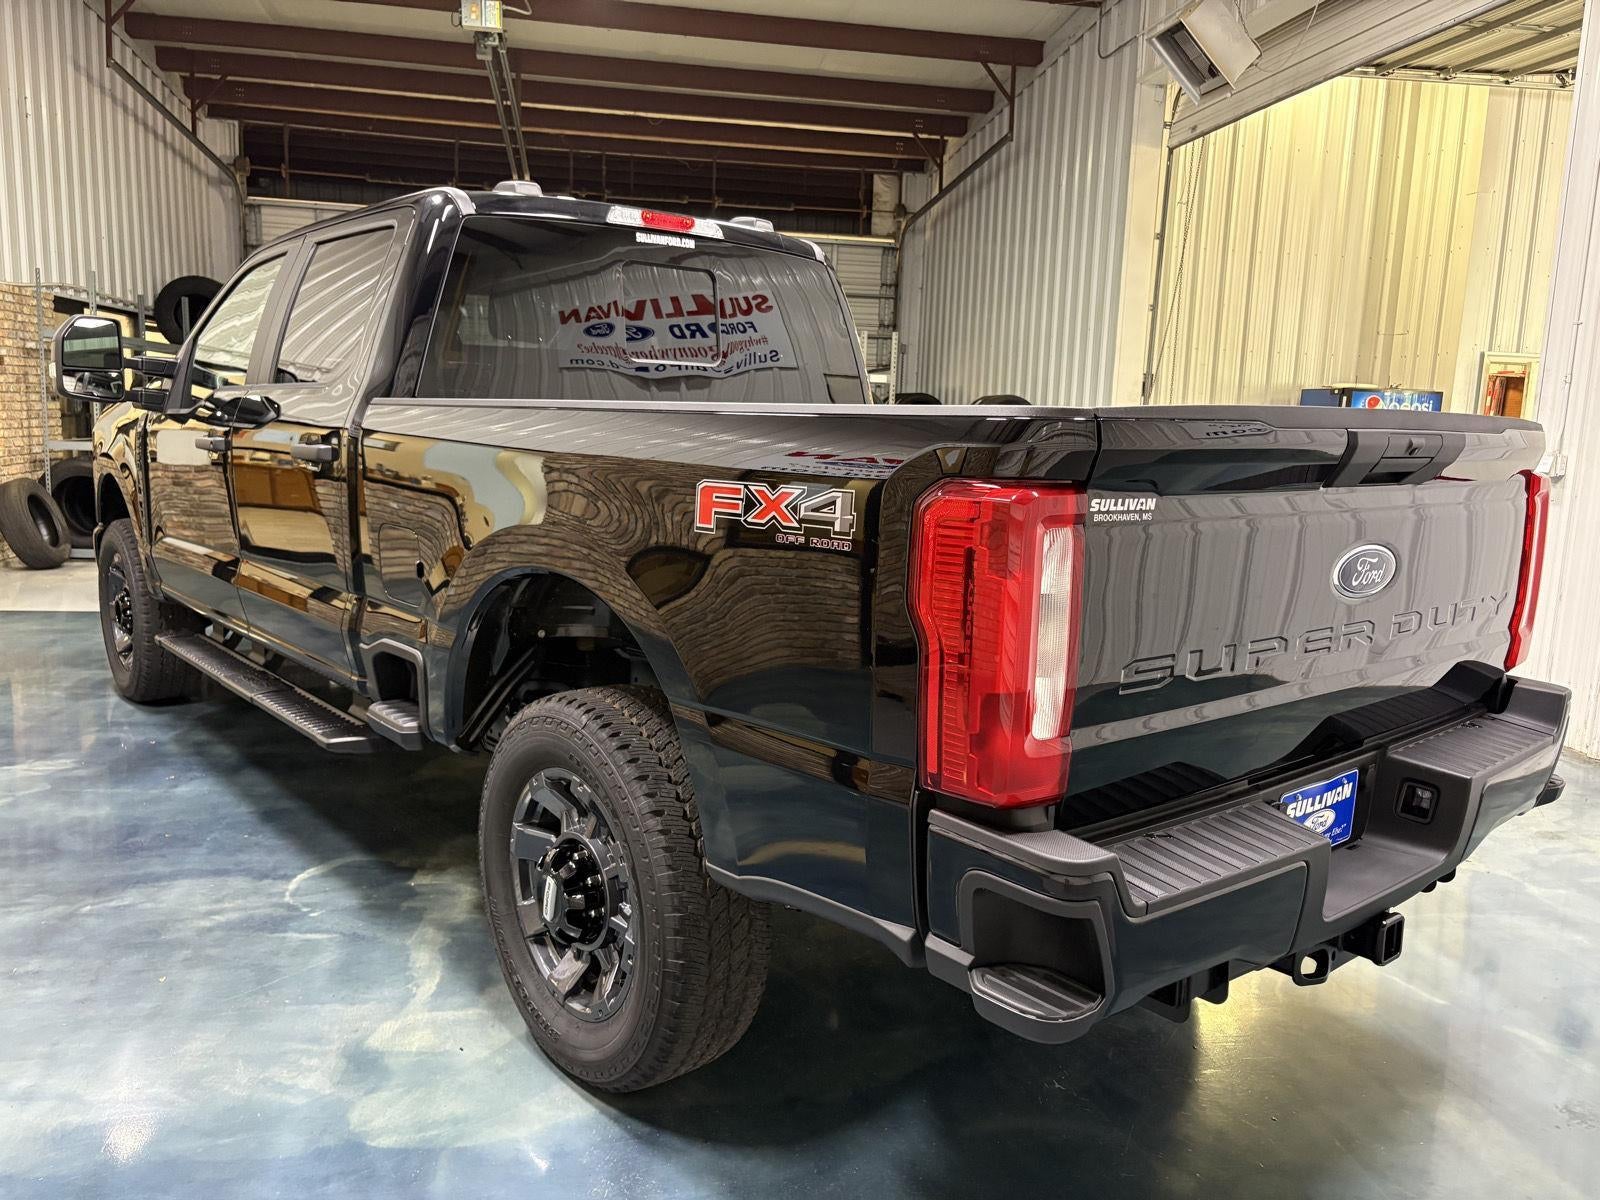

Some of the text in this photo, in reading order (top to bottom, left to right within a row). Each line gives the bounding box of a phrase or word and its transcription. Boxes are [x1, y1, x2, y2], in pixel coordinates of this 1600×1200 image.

[635, 231, 696, 249] SULLIVANFORD.COM
[694, 479, 856, 539] FX4
[1089, 498, 1157, 512] SULLIVAN
[1093, 512, 1153, 522] BROOKHAVEN, MS
[775, 533, 852, 551] OFF ROAD
[1352, 557, 1386, 587] Ford
[1118, 591, 1509, 695] SUPER DUTY
[1286, 781, 1353, 819] SULLIVAN
[1311, 811, 1330, 832] Ford
